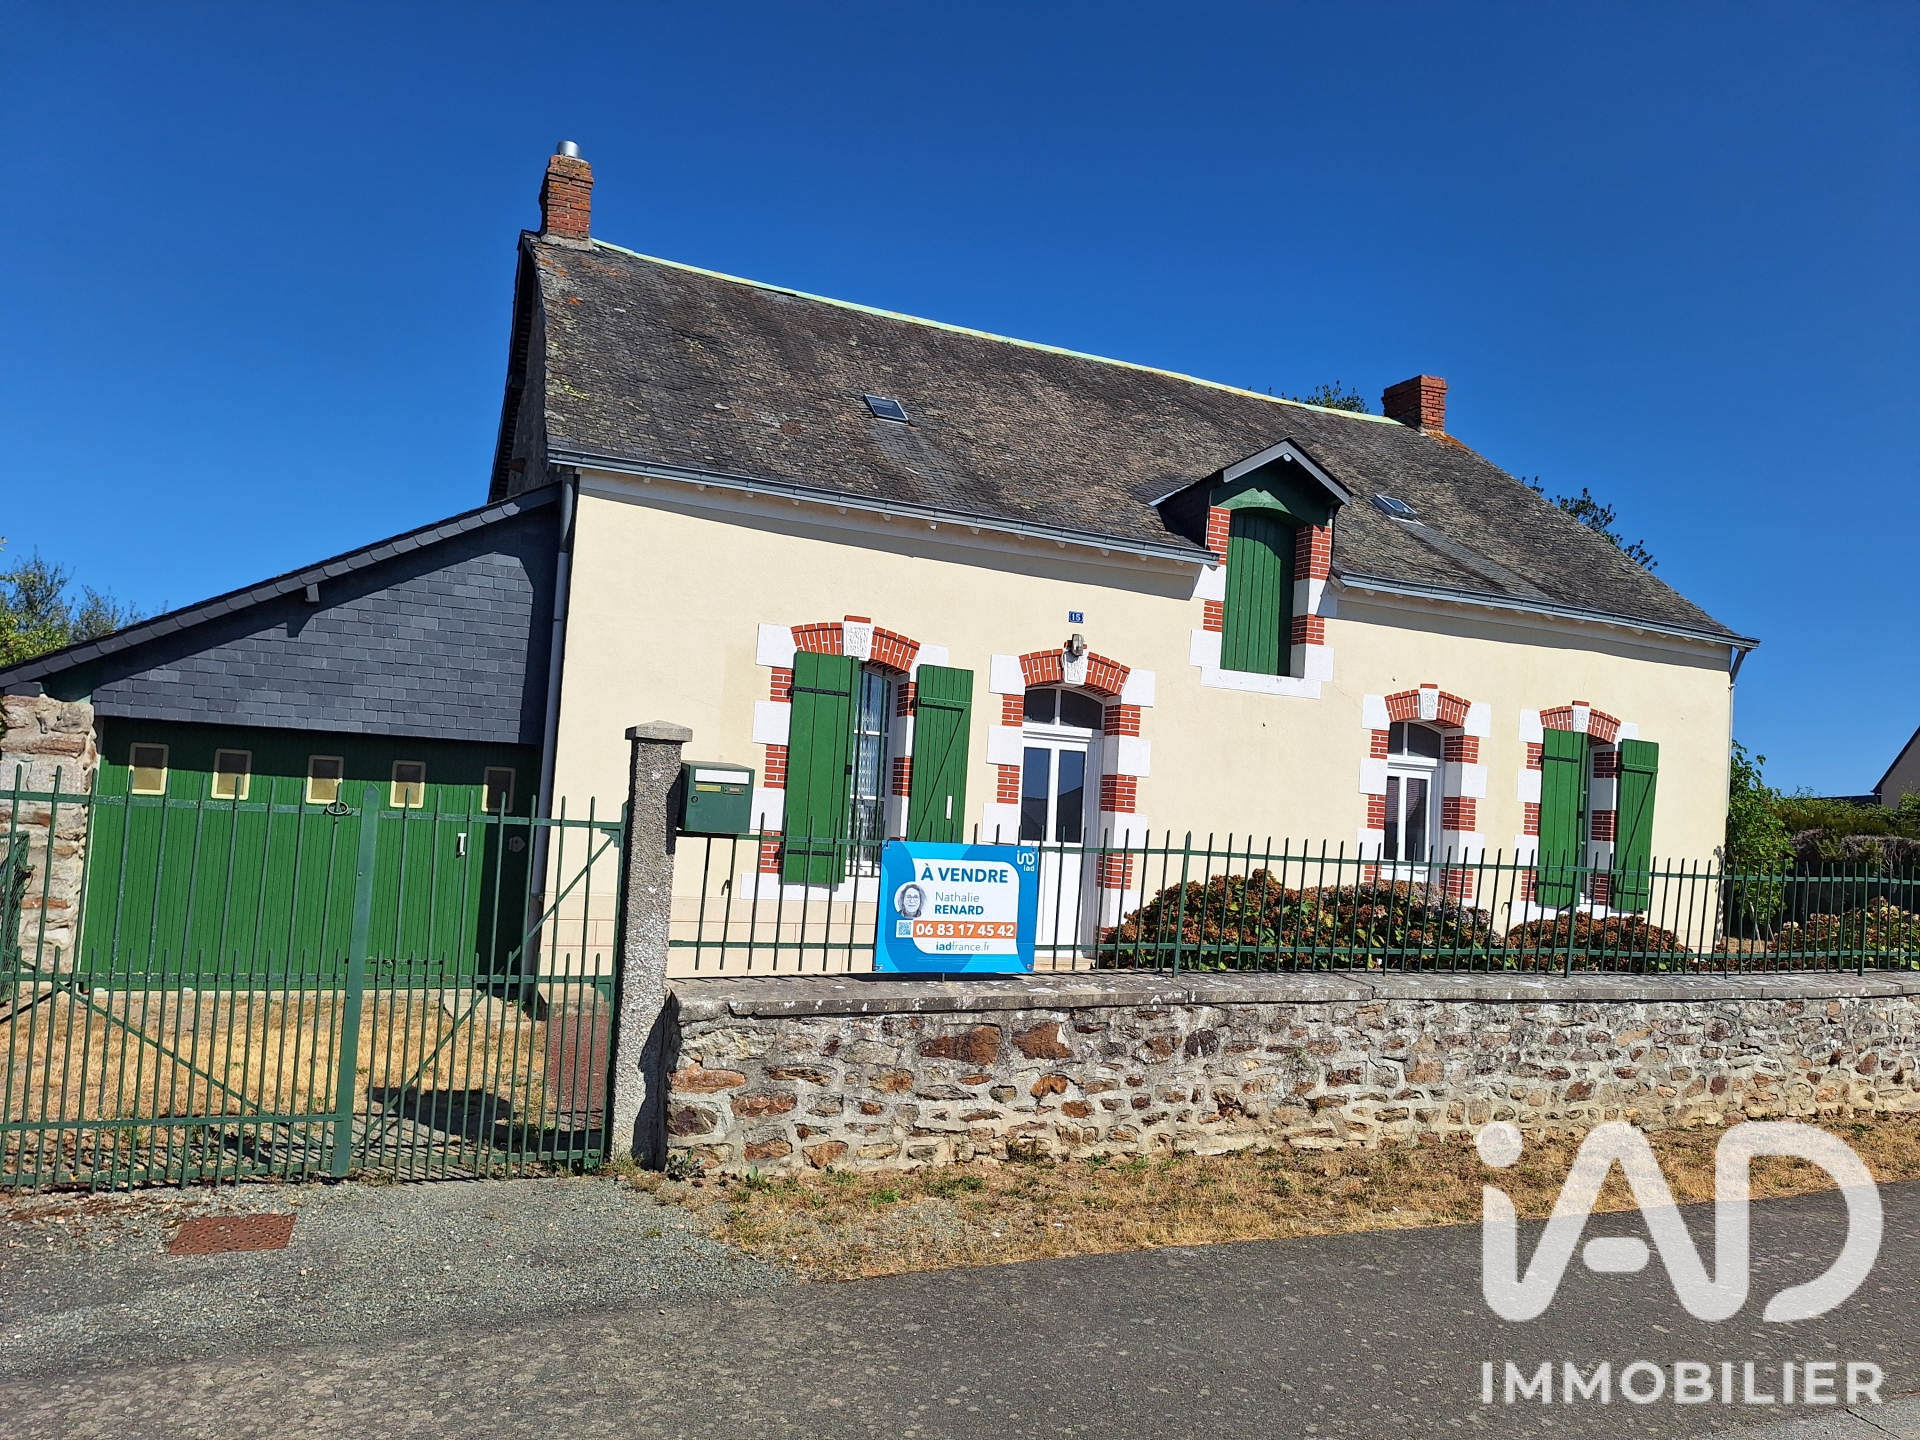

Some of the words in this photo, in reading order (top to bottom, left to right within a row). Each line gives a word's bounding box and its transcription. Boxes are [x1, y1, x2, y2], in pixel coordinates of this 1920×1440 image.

[1072, 613, 1081, 621] 15
[920, 863, 934, 881] À
[938, 867, 1009, 883] VENDRE
[935, 891, 980, 903] Nathalie
[934, 904, 985, 915] RENARD
[915, 923, 934, 936] 06
[936, 924, 954, 936] 83
[957, 924, 974, 936] 17
[977, 924, 995, 937] 45
[997, 924, 1015, 937] 42
[936, 941, 991, 952] iadfrance.fr
